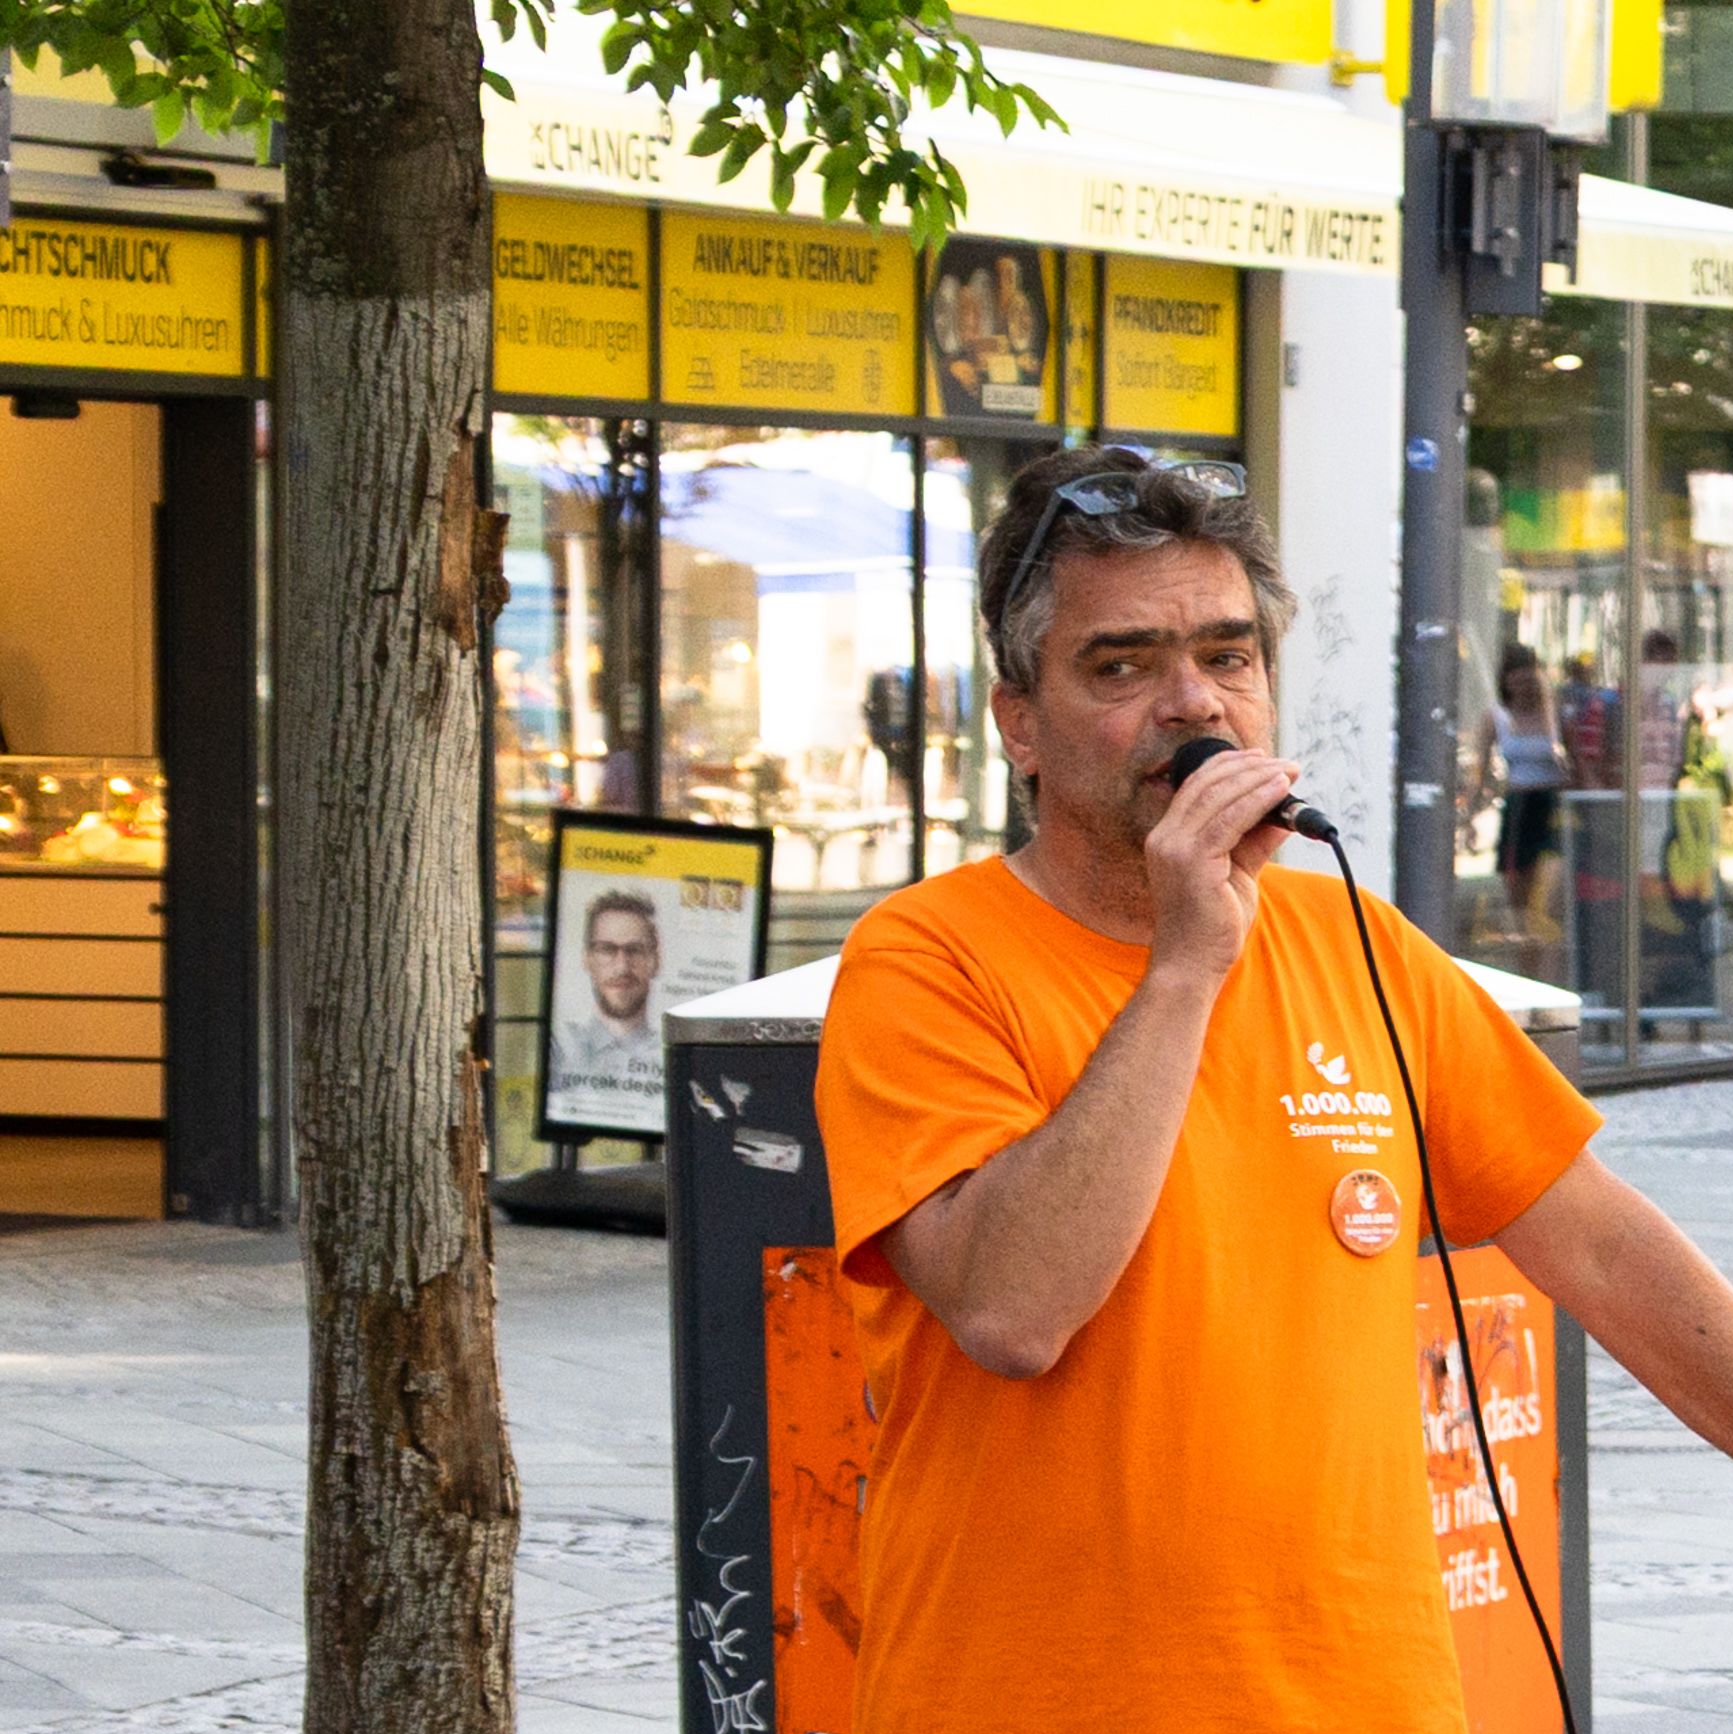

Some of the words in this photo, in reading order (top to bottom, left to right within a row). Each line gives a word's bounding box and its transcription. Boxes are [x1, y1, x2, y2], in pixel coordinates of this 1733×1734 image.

[1081, 178, 1124, 236] IHR
[1135, 184, 1242, 250] EXPERTE
[1249, 190, 1294, 255] FÜR
[496, 236, 640, 290] GELDWECHSEL
[693, 232, 773, 278] ANKAUF
[795, 243, 881, 286] VERKAUF
[78, 298, 96, 344] &
[103, 301, 228, 352] Luxusuhren
[534, 306, 640, 362] Währungen
[1279, 1091, 1392, 1117] 1.000.000
[1289, 1122, 1356, 1138] Stimmen
[1331, 1139, 1379, 1155] Frieden
[1482, 1385, 1543, 1445] dass
